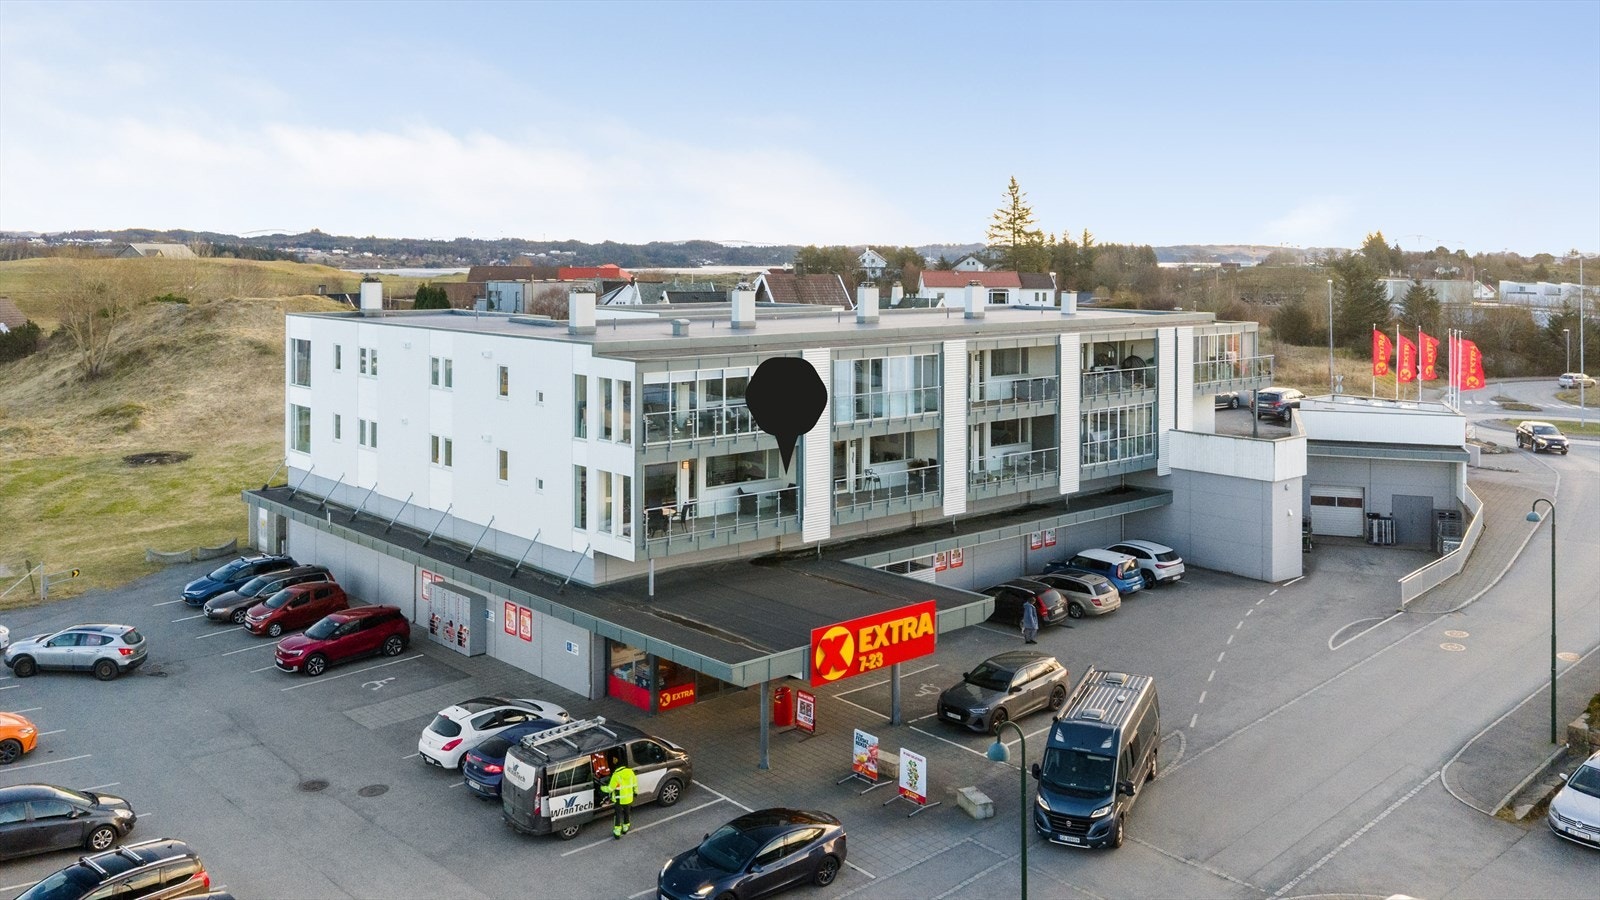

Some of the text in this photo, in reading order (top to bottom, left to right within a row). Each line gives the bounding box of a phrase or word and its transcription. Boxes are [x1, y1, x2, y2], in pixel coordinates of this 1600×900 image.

[859, 612, 934, 653] EXTRA
[859, 652, 883, 672] 7-23
[672, 690, 694, 701] EXTRA
